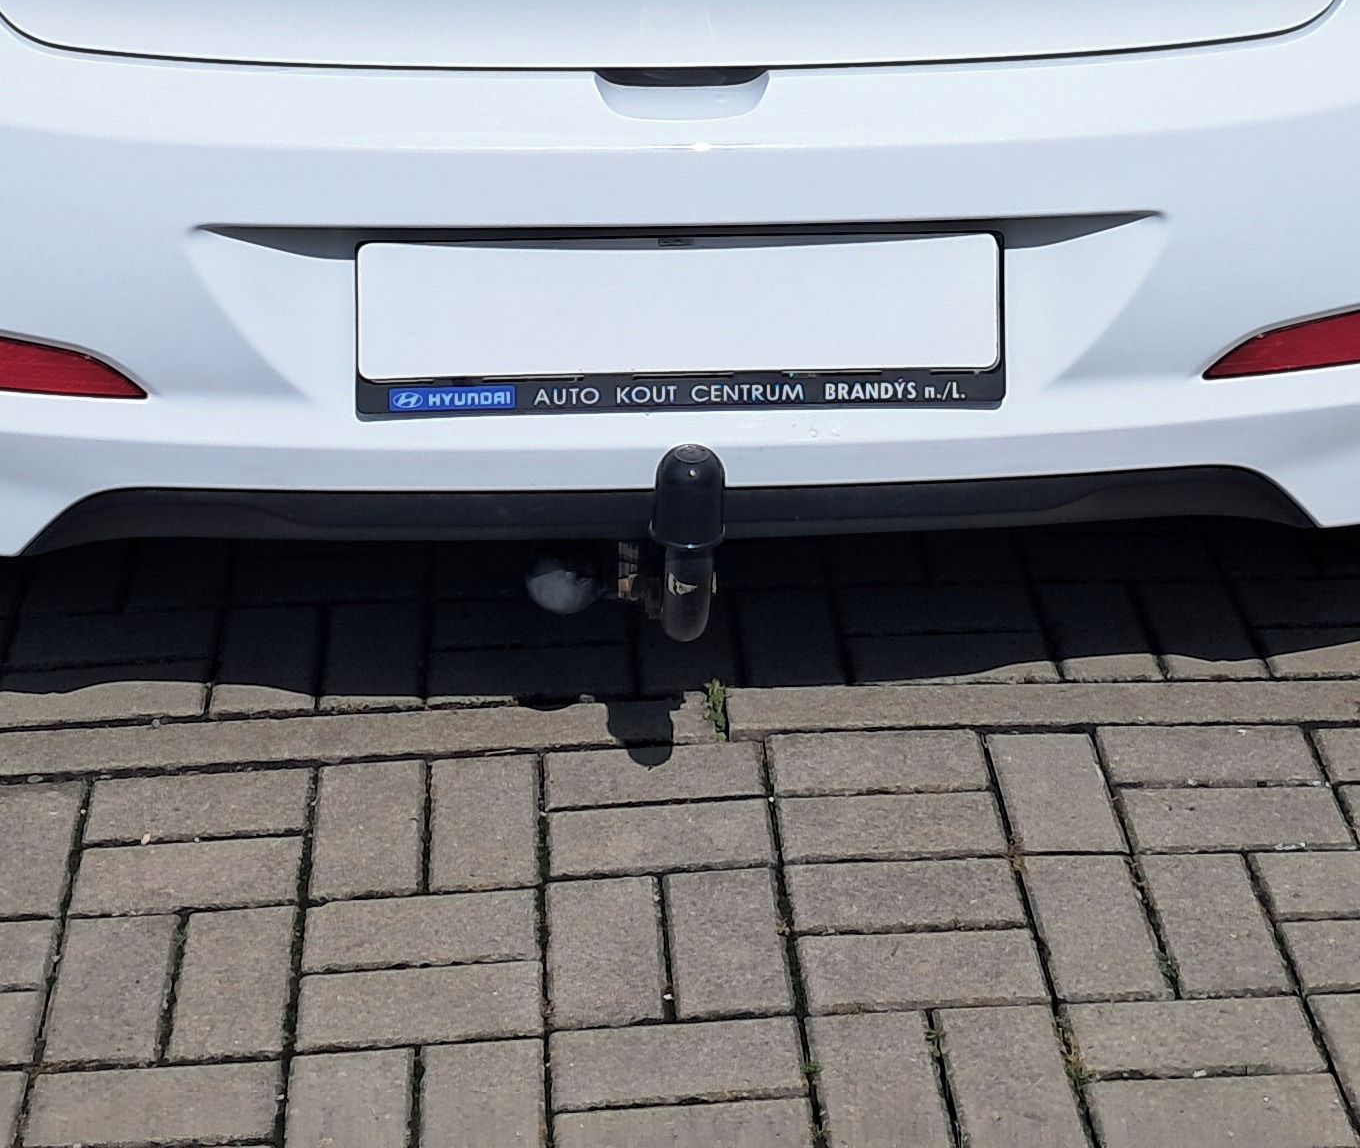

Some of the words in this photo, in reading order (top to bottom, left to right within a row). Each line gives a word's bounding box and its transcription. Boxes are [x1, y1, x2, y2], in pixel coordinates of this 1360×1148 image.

[428, 390, 511, 407] HYUNDAI
[533, 387, 600, 406] AUTO
[616, 385, 678, 404] KOUT
[691, 383, 804, 403] CENTRUM
[824, 379, 917, 401] BRANDÝS
